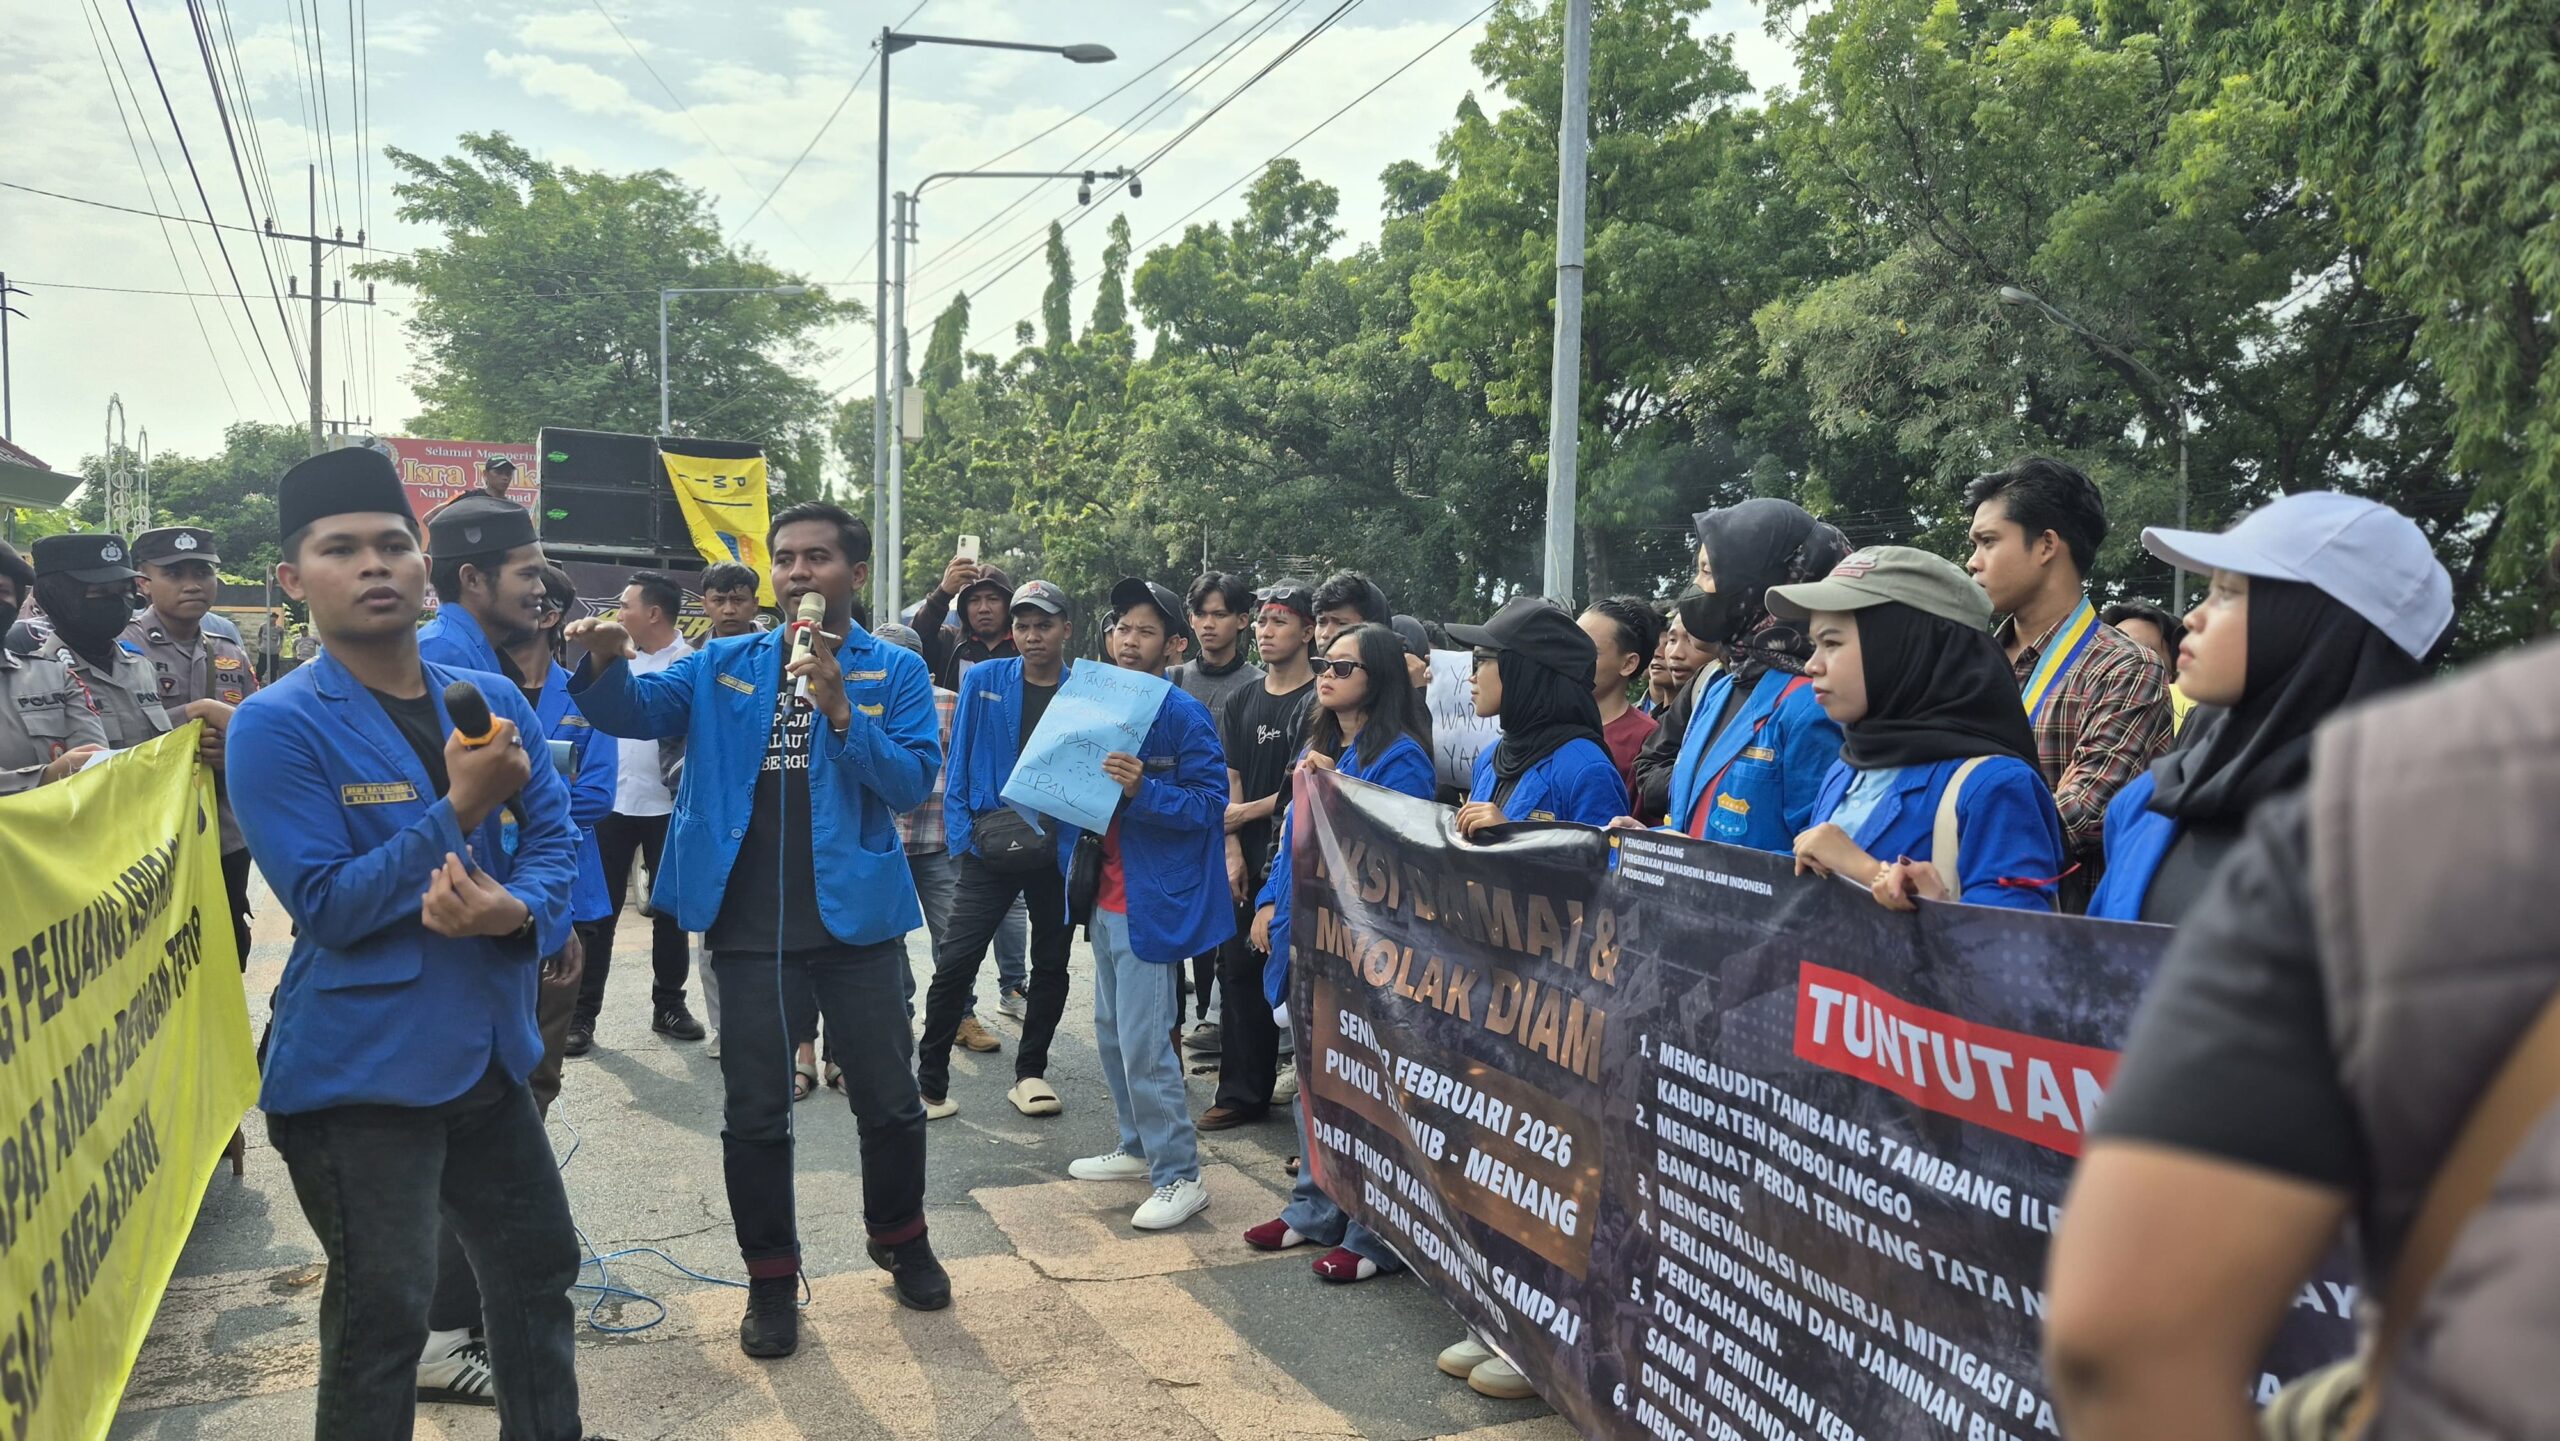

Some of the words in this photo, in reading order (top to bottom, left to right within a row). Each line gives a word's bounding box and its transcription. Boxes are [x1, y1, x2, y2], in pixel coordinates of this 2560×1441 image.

[402, 457, 467, 487] Isra
[419, 488, 449, 499] Nabi
[18, 692, 66, 708] POLR
[1622, 867, 1665, 887] PROBOLINGGO
[1623, 852, 1663, 870] PERGERAKAN
[1663, 860, 1705, 881] MAHASISWA
[1705, 871, 1729, 886] ISLAM
[1729, 876, 1773, 896] INDONESIA
[1624, 837, 1657, 853] PENGURUS
[1657, 844, 1685, 859] CABANG
[12, 889, 126, 1044] PEJUANG
[1485, 969, 1607, 1085] DIAM
[0, 1096, 49, 1259] PAT
[53, 1027, 113, 1174] ANDA
[1325, 1048, 1382, 1101] PUKUL
[1464, 1147, 1579, 1237] MENANG
[1395, 1056, 1513, 1137] FEBRUARI
[1514, 1111, 1573, 1168] 2026
[1639, 1033, 1651, 1059] 1.
[1659, 1042, 1769, 1107] MENGAUDIT
[1771, 1086, 2011, 1219] TAMBANG-TAMBANG
[1657, 1077, 1766, 1147] KABUPATEN
[1769, 1126, 1921, 1229] PROBOLINGGO.
[1313, 1116, 1351, 1157] DARI
[1354, 1134, 1393, 1183] RUKO
[1491, 1265, 1581, 1346] SAMPAI
[1365, 1180, 1410, 1237] DEPAN
[1412, 1220, 1472, 1292] GEDUNG
[1635, 1103, 1649, 1130] 2.
[1656, 1113, 1751, 1177] MEMBUAT
[1754, 1158, 1809, 1215] PERDA
[1812, 1192, 1924, 1272] TENTANG
[1928, 1249, 2015, 1310] TATA
[1657, 1148, 1744, 1214] BAWANG.
[0, 1258, 57, 1441] SIAP
[61, 1098, 160, 1322] MELAYANI
[1637, 1173, 1651, 1200] 3.
[1658, 1184, 1797, 1284] MENGEVALUASI
[1800, 1264, 1898, 1341] KINERJA
[1904, 1318, 2014, 1411] MITIGASI
[1637, 1209, 1652, 1235] 4.
[1659, 1219, 1803, 1327] PERLINDUNGAN
[1808, 1306, 1855, 1359] DAN
[1859, 1341, 1966, 1433] JAMINAN
[1657, 1255, 1783, 1358] PERUSAHAAN.
[1612, 1382, 1628, 1412] 6.
[1630, 1276, 1645, 1306] 5.
[1654, 1290, 1711, 1348] TOLAK
[1712, 1330, 1816, 1425] PEMILIHAN
[1641, 1362, 1704, 1428] DIPILIH
[1645, 1327, 1697, 1382] SAMA
[1704, 1367, 1804, 1441] MENAND
